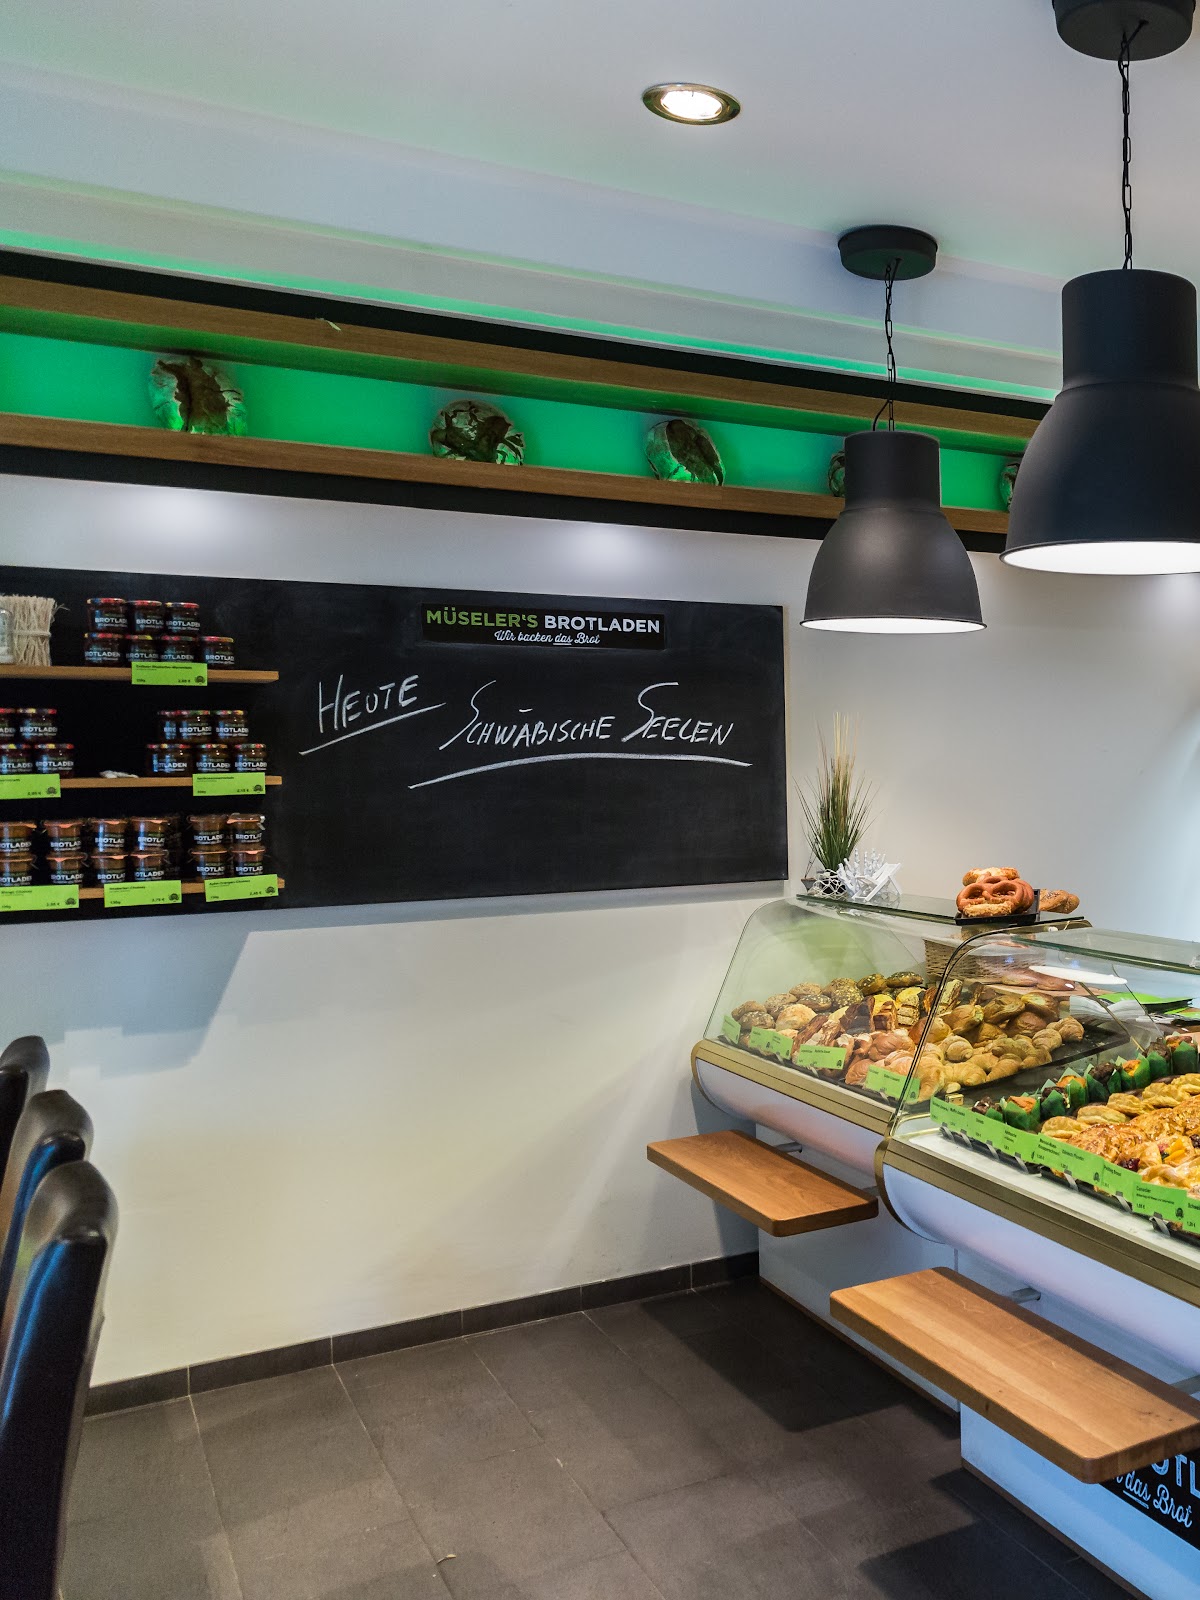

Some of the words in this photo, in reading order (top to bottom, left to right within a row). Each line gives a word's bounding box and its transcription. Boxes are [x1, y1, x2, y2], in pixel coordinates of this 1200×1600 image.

[494, 630, 516, 642] Wir
[518, 631, 553, 643] backen
[553, 634, 573, 644] das
[574, 633, 601, 645] Brot
[544, 615, 660, 633] BROTLADEN
[318, 674, 420, 734] HEUTE
[1152, 1484, 1193, 1528] Brot
